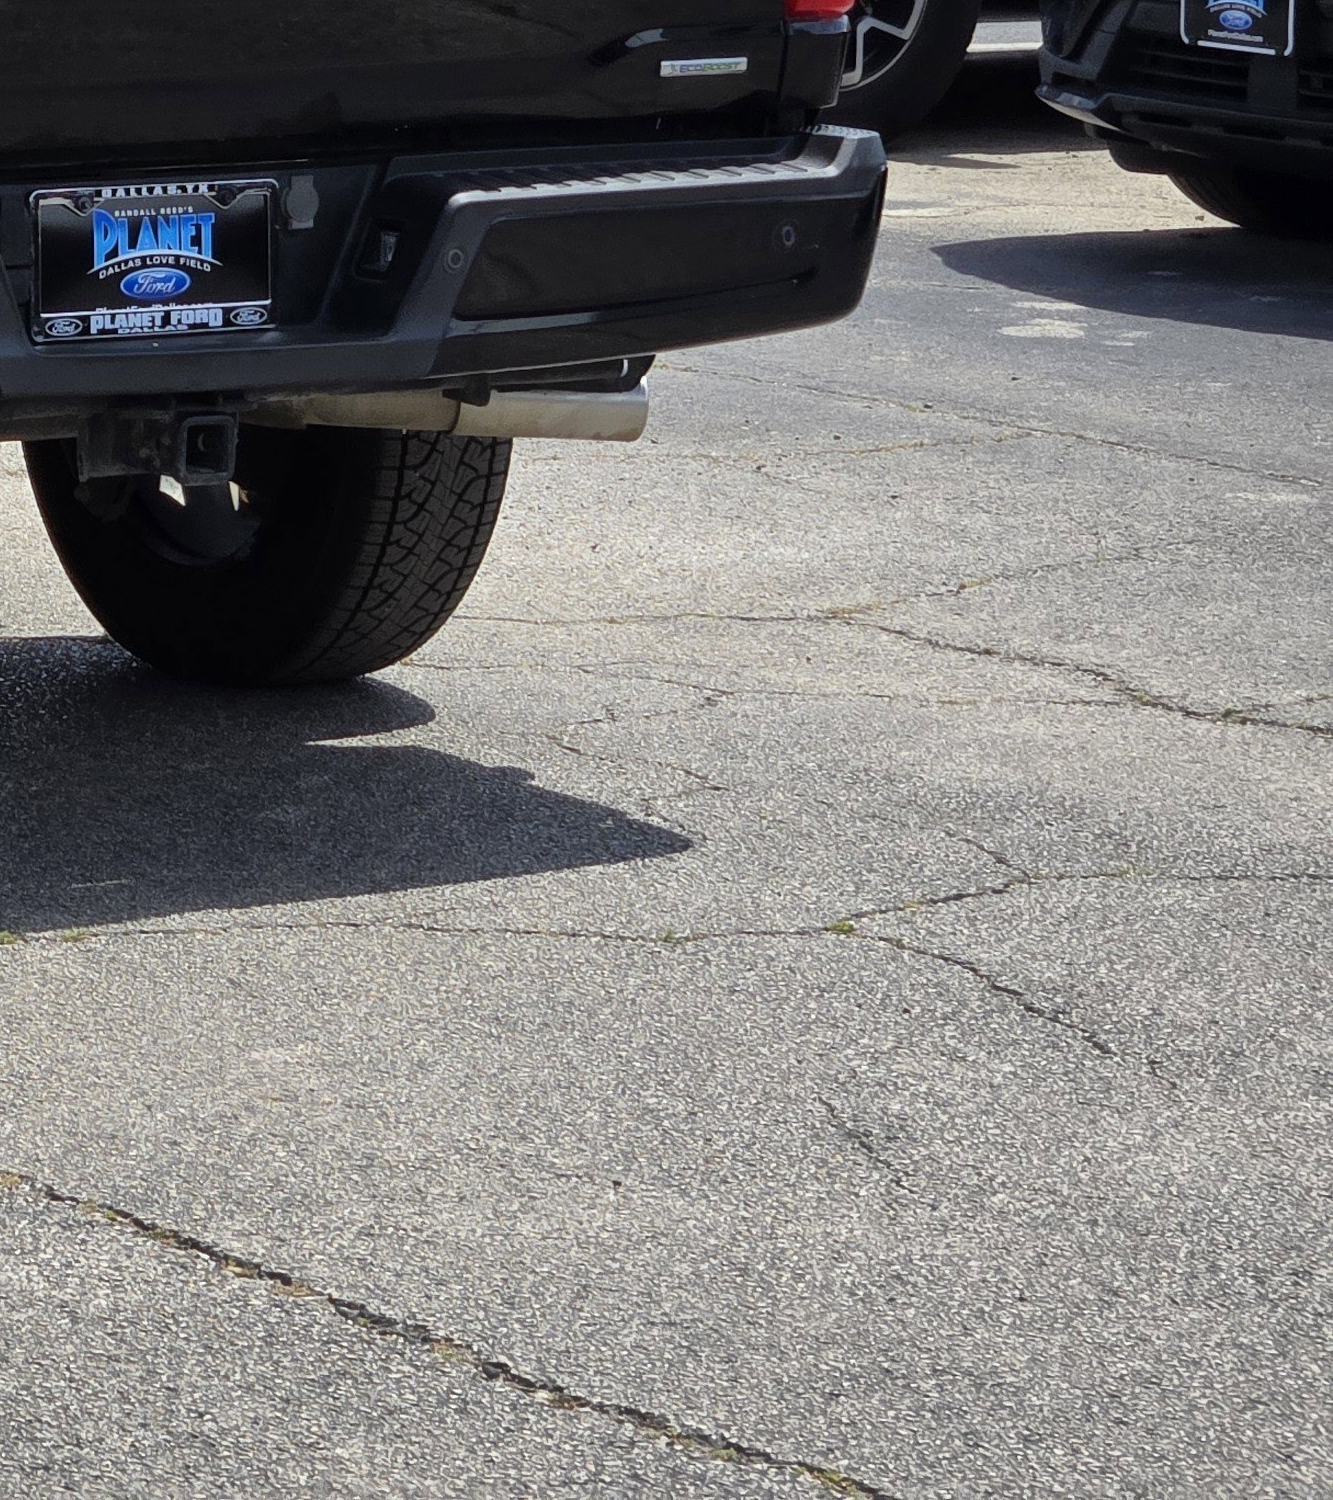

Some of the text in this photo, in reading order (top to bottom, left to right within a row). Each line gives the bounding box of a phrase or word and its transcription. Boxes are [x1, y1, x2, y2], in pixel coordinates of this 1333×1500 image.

[92, 208, 216, 269] PLANET
[99, 255, 212, 280] DALLAS LOVE FIELD
[133, 273, 176, 295] Ford
[89, 311, 165, 335] PLANET
[170, 307, 224, 328] FORD
[117, 323, 189, 335] DALLAS
